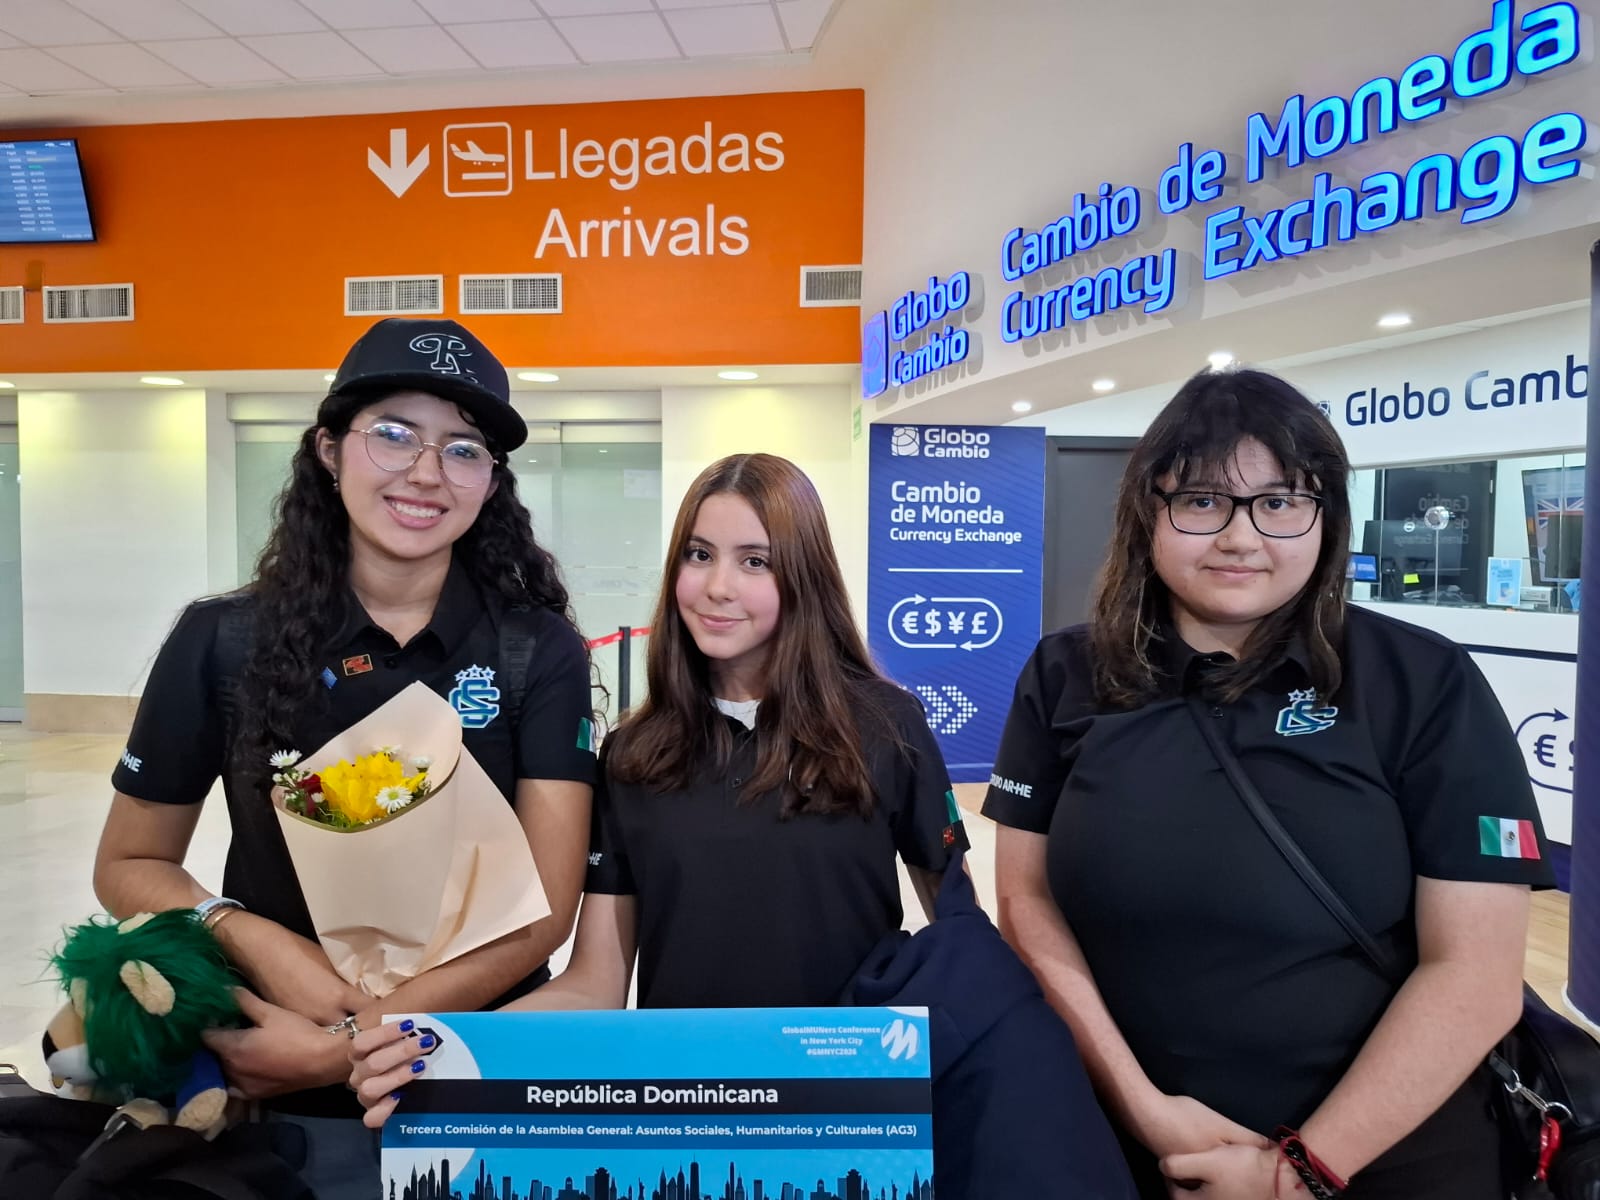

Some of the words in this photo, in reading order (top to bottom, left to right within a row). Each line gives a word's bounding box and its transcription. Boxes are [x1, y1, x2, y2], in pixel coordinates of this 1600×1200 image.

[1001, 182, 1140, 281] Cambio
[1158, 142, 1227, 216] de
[1246, 0, 1581, 183] Moneda
[524, 121, 785, 191] Llegadas
[534, 204, 750, 259] Arrivals
[1001, 247, 1176, 344] Currency
[1203, 112, 1587, 279] Exchange
[890, 271, 970, 342] Globo
[891, 325, 969, 387] Cambio
[1345, 381, 1451, 427] Globo
[924, 428, 991, 445] Globo
[924, 444, 991, 459] Cambio
[891, 480, 981, 504] Cambio
[890, 504, 917, 523] de
[921, 504, 1005, 524] Moneda
[890, 527, 952, 544] Currency
[954, 528, 1023, 545] Exchange
[1002, 778, 1033, 799] AR-HE
[800, 1037, 808, 1045] in
[828, 1037, 846, 1045] York
[847, 1037, 863, 1046] City
[837, 1026, 881, 1034] Conference
[527, 1084, 637, 1107] República
[643, 1084, 779, 1104] Dominicana
[399, 1124, 442, 1135] Tercera
[444, 1124, 497, 1135] Comisión
[499, 1124, 514, 1135] de
[516, 1124, 526, 1135] la
[528, 1125, 584, 1136] Asamblea
[586, 1125, 633, 1136] General:
[635, 1125, 682, 1136] Asuntos
[684, 1125, 734, 1137] Sociales,
[736, 1124, 814, 1136] Humanitarios
[815, 1127, 822, 1137] y
[825, 1124, 884, 1135] Culturales
[886, 1124, 917, 1137] (AG3)
